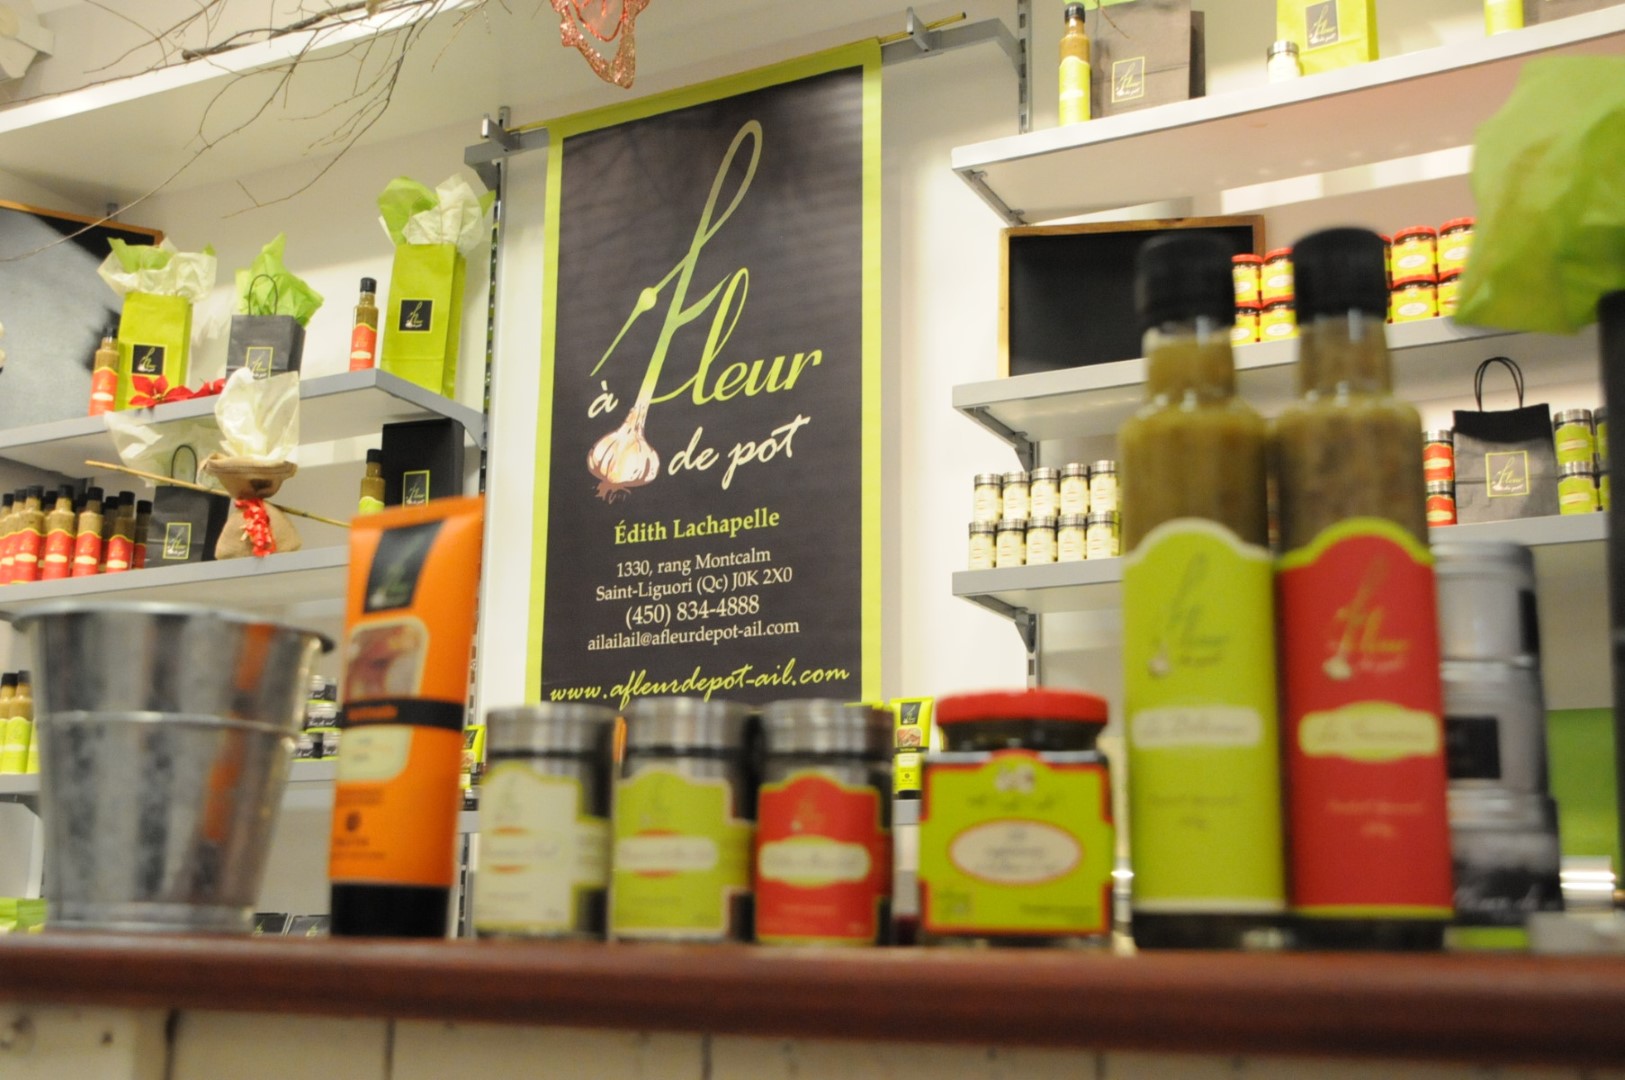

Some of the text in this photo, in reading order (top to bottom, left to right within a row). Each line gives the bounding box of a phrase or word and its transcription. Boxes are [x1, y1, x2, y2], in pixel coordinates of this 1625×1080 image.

[668, 426, 719, 476] de
[614, 507, 780, 545] Édith Lachapelle
[616, 547, 771, 578] 1330, rang Montcalm
[596, 577, 692, 602] Saint-Liguori
[696, 573, 728, 596] (Qc)
[625, 594, 760, 630] (450) 834-4888
[587, 619, 800, 651] ailailail@afleurdepot-ail.com
[550, 657, 850, 711] www.afleurdepot-ail.com
